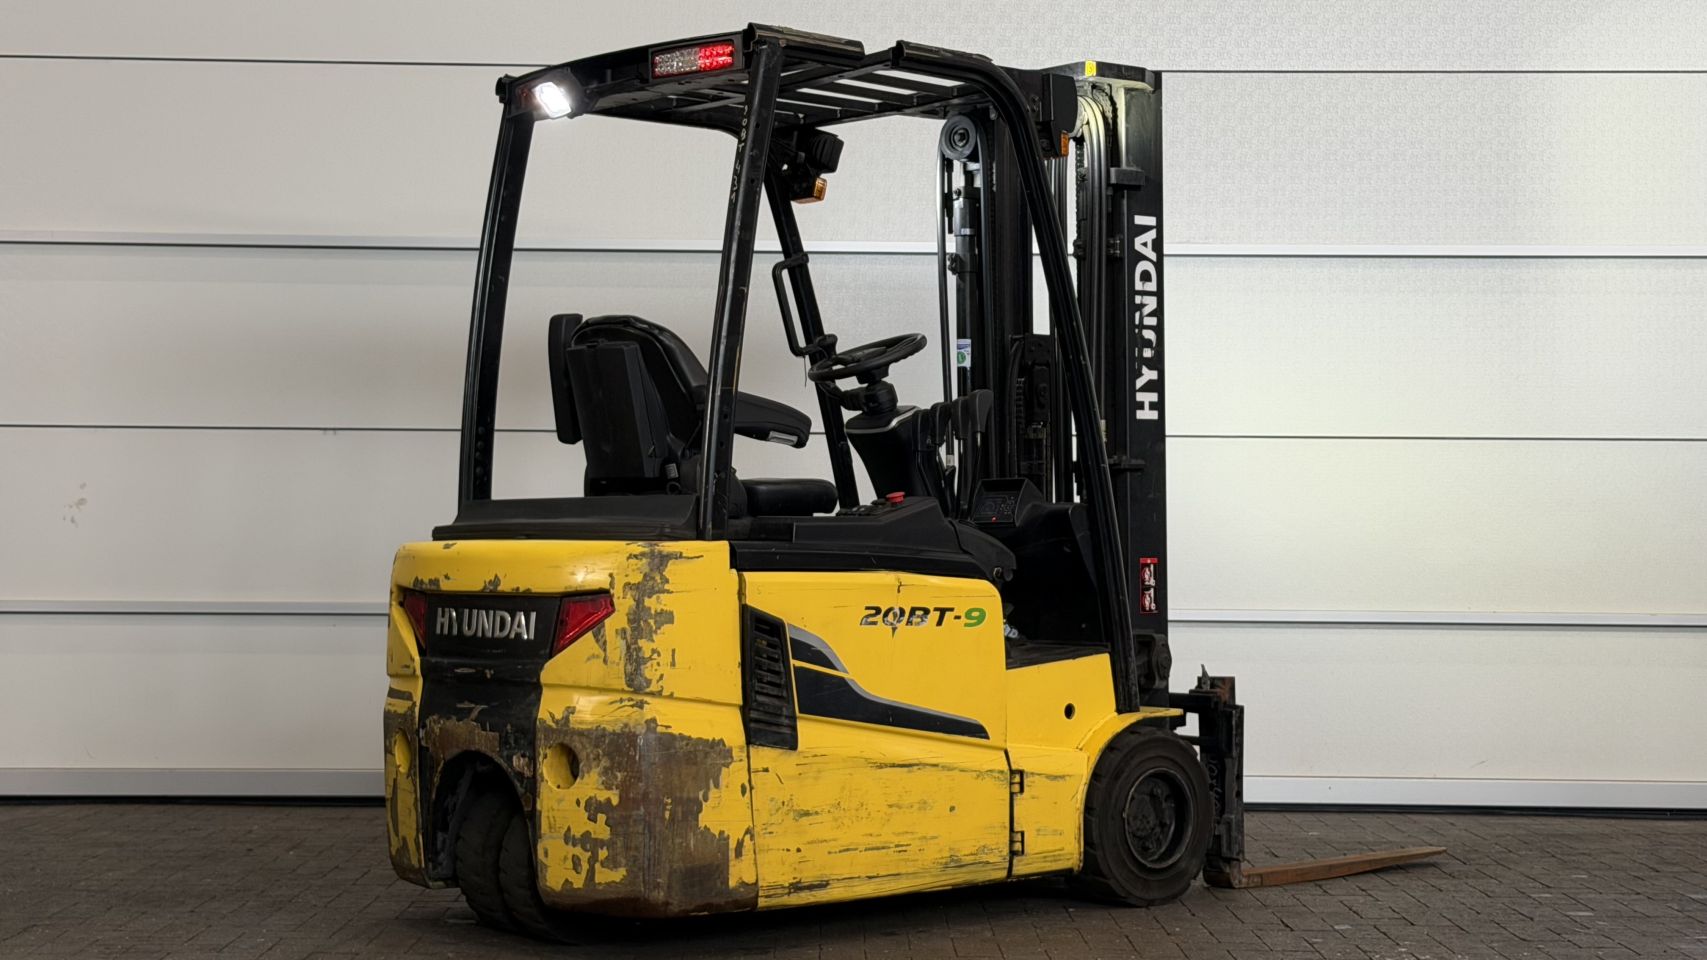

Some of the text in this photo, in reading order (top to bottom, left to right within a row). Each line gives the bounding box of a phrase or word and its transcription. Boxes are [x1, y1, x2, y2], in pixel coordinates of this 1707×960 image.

[1134, 215, 1159, 420] HYUNDAI
[436, 607, 537, 640] HYUNDAI
[859, 606, 987, 628] 20BT-9
